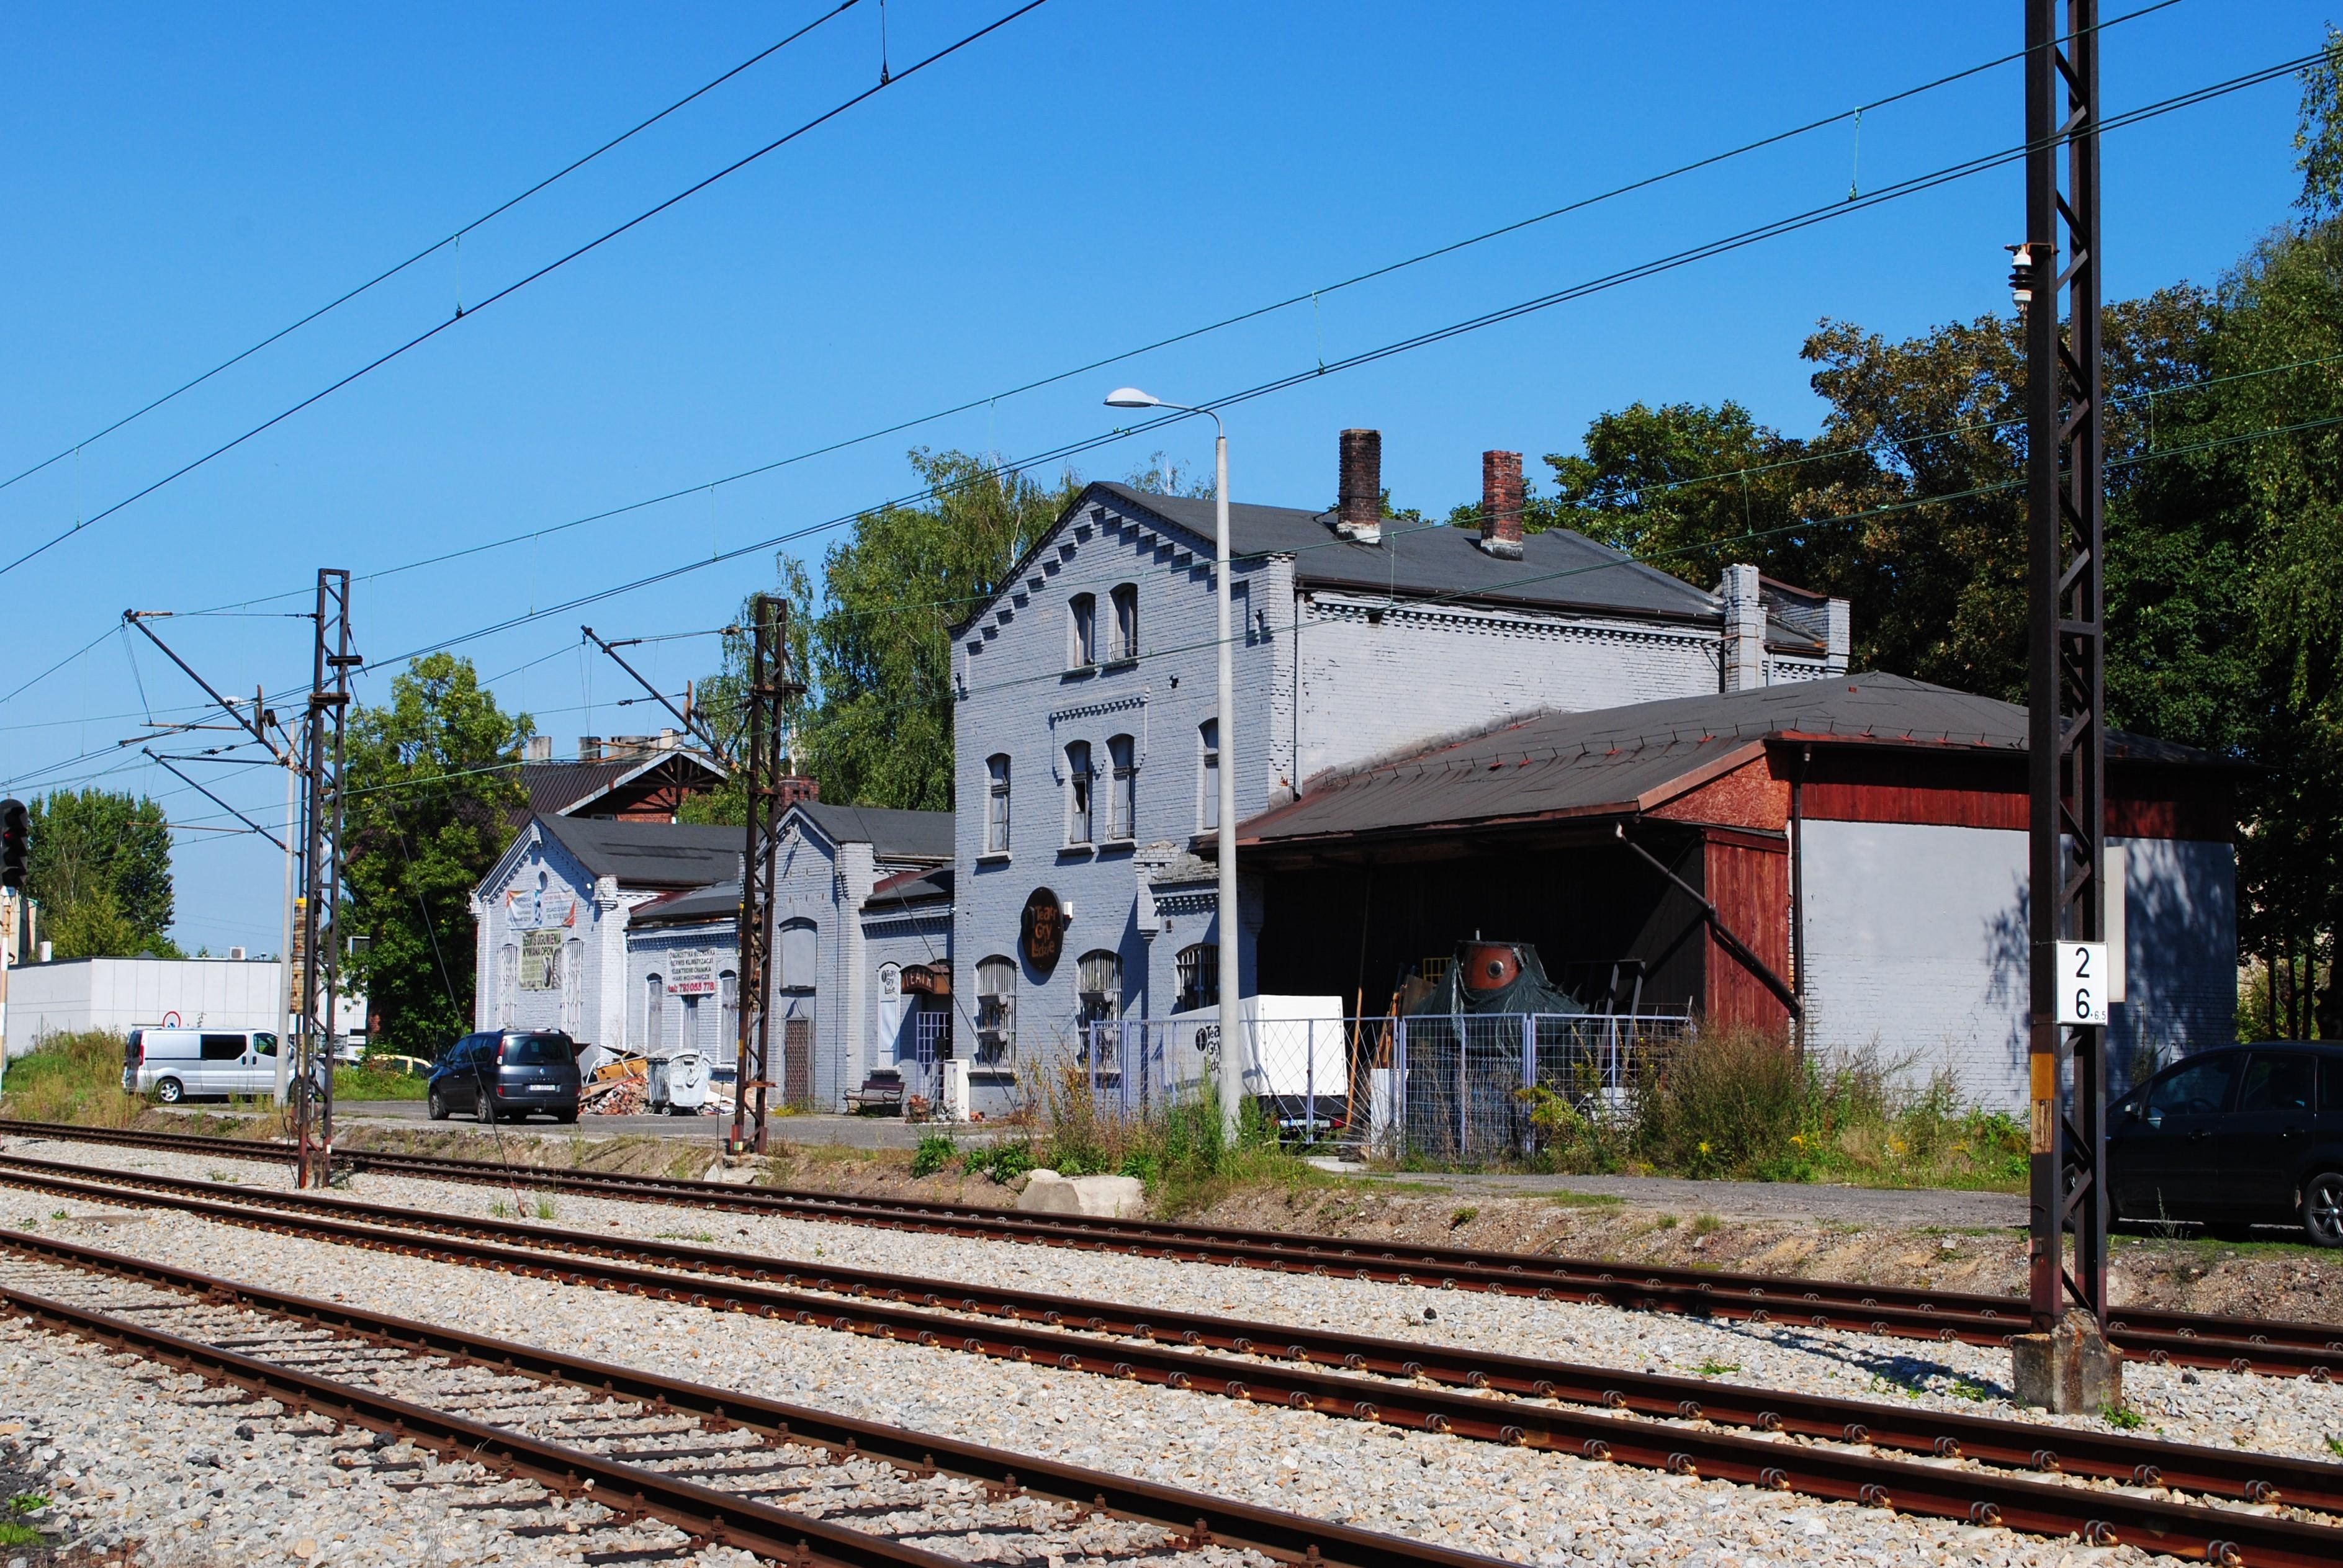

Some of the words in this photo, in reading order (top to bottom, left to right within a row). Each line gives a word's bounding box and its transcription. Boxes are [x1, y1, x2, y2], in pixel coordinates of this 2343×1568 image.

[1035, 905, 1058, 921] Teatr
[1035, 923, 1053, 940] Gry
[541, 946, 554, 956] OPON
[1032, 938, 1055, 957] Ludzie
[2075, 947, 2090, 978] 2
[703, 982, 714, 990] 778
[905, 969, 932, 987] TEATR
[2076, 988, 2090, 1019] 6
[1205, 1025, 1220, 1039] Tea
